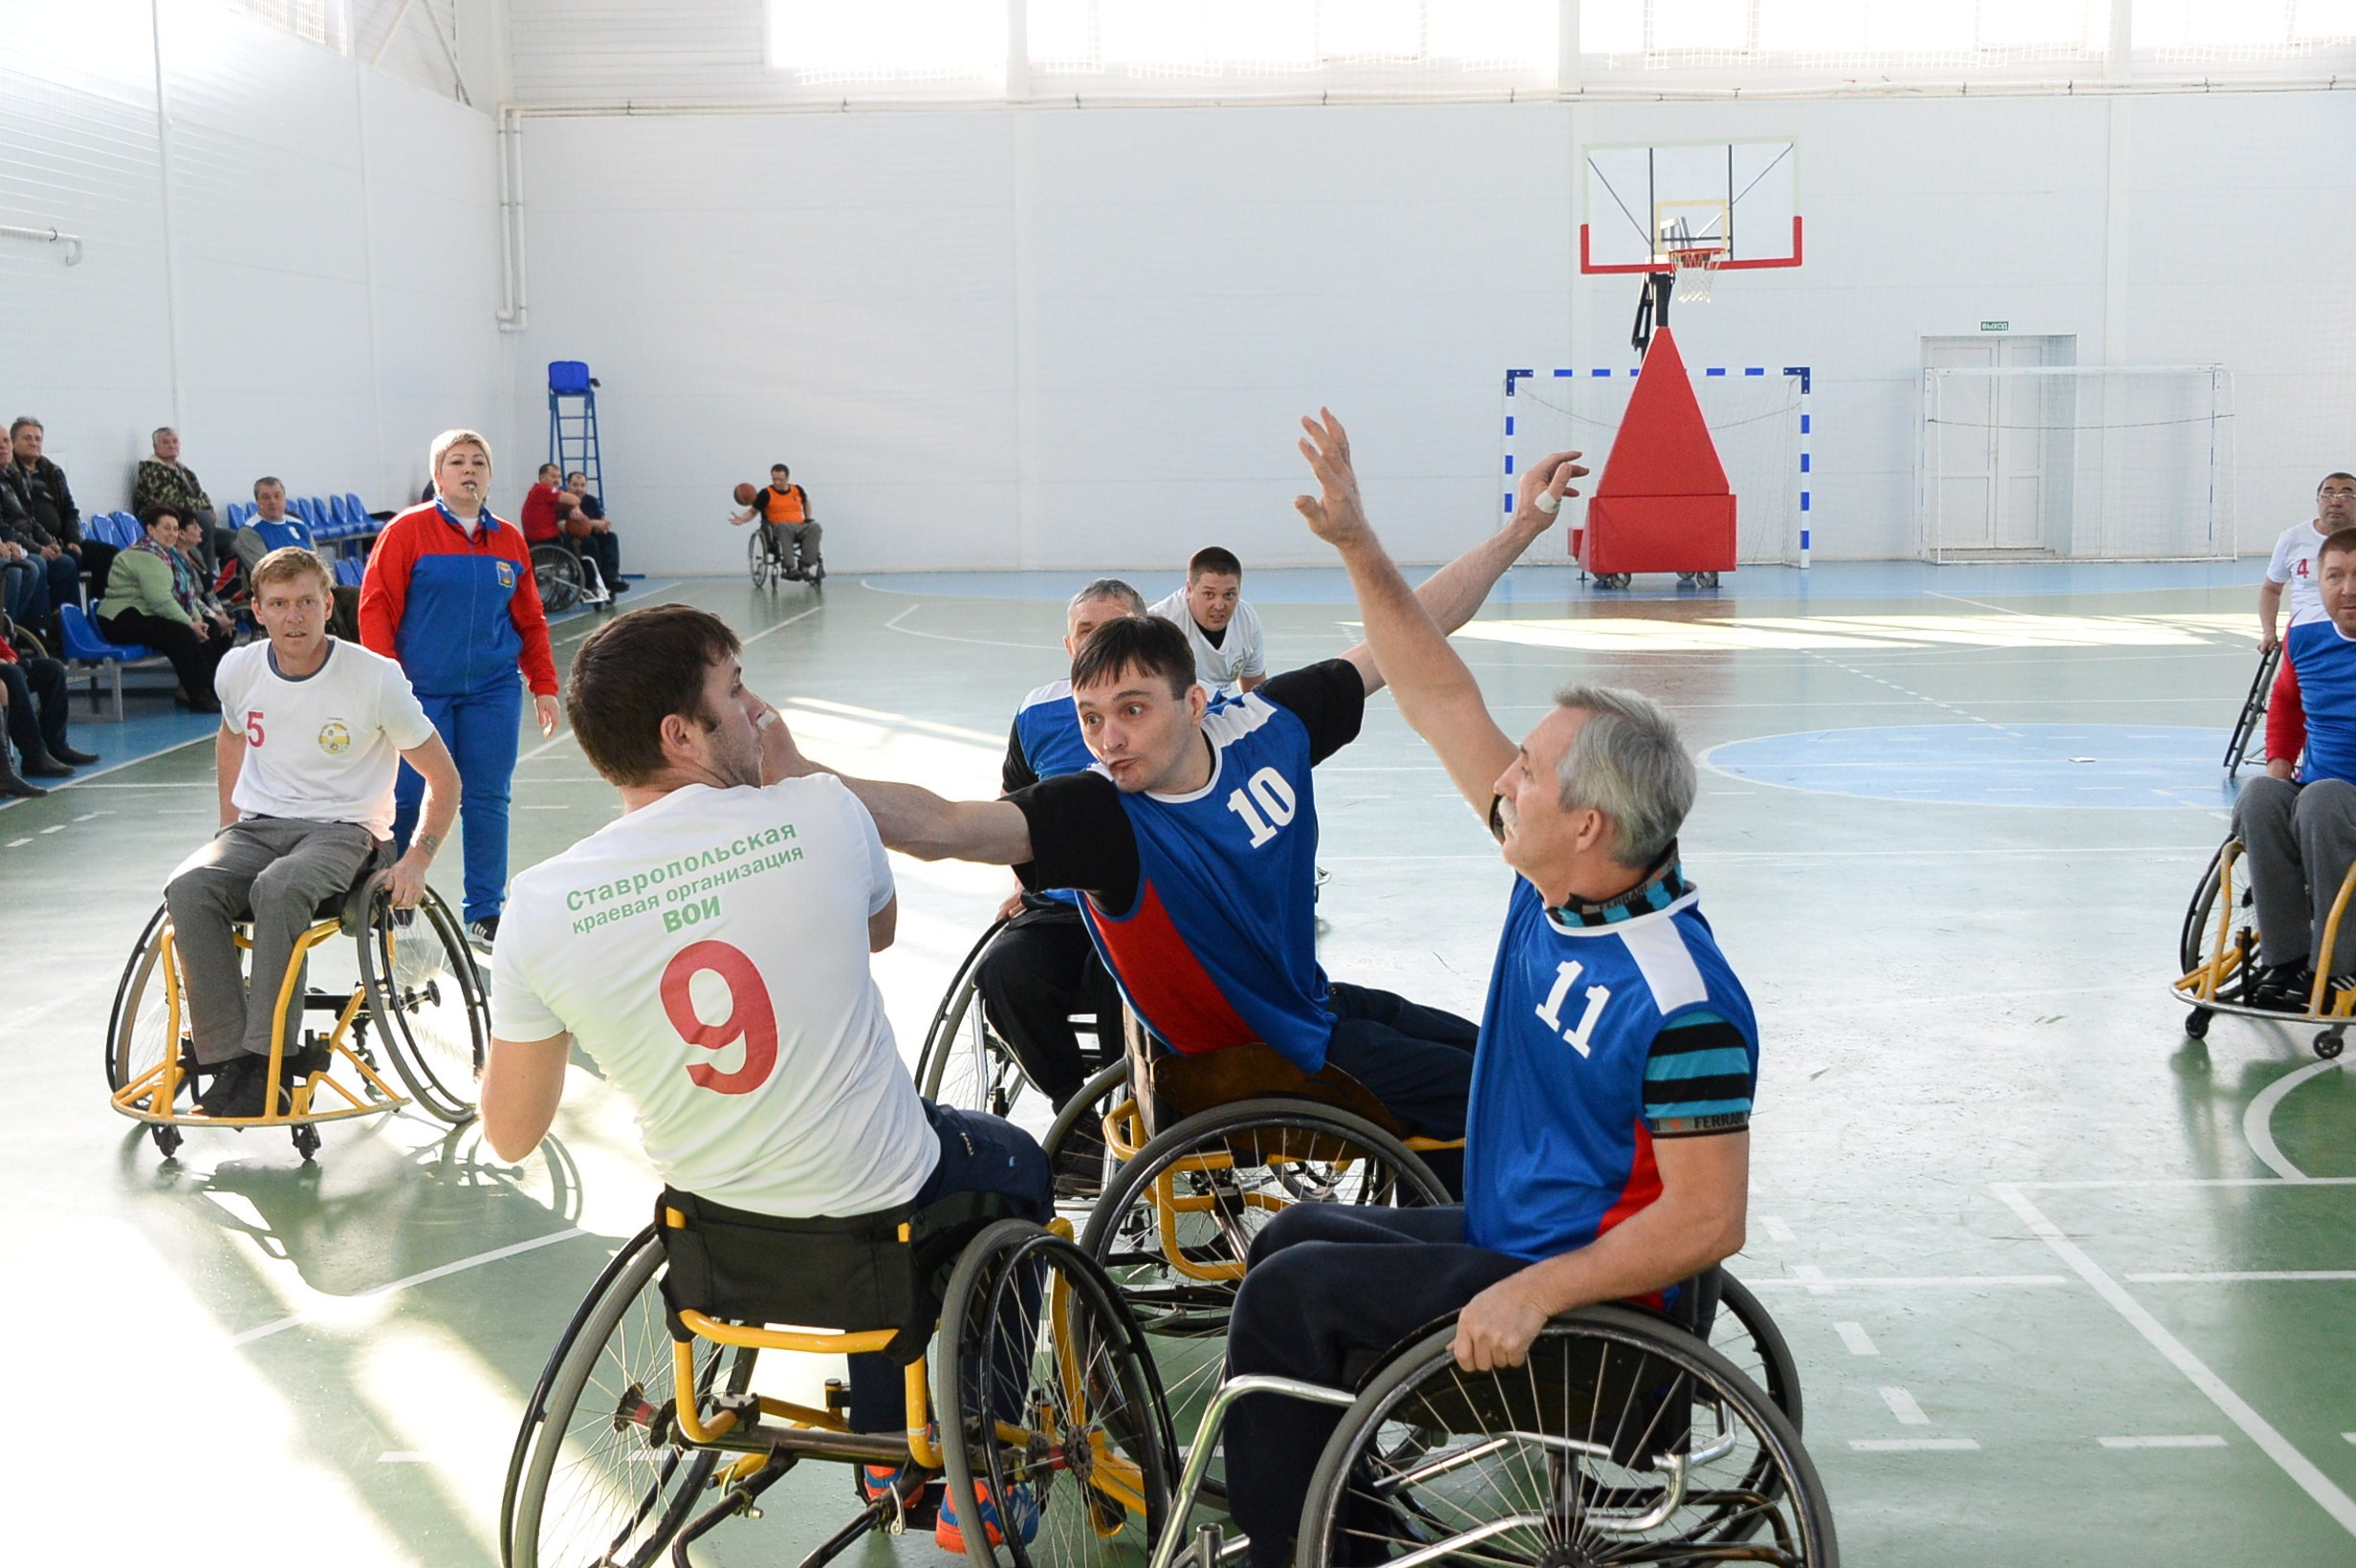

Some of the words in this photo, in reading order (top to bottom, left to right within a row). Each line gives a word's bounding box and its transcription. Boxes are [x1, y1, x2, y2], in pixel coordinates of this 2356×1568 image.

[2297, 557, 2310, 579] 4
[248, 711, 265, 748] 5
[1226, 766, 1297, 850] 10
[566, 823, 797, 911] Ставропольская
[572, 894, 661, 935] краевая
[665, 846, 805, 902] организация
[662, 895, 722, 934] ВОИ
[659, 939, 779, 1096] 9
[1535, 959, 1611, 1059] 11
